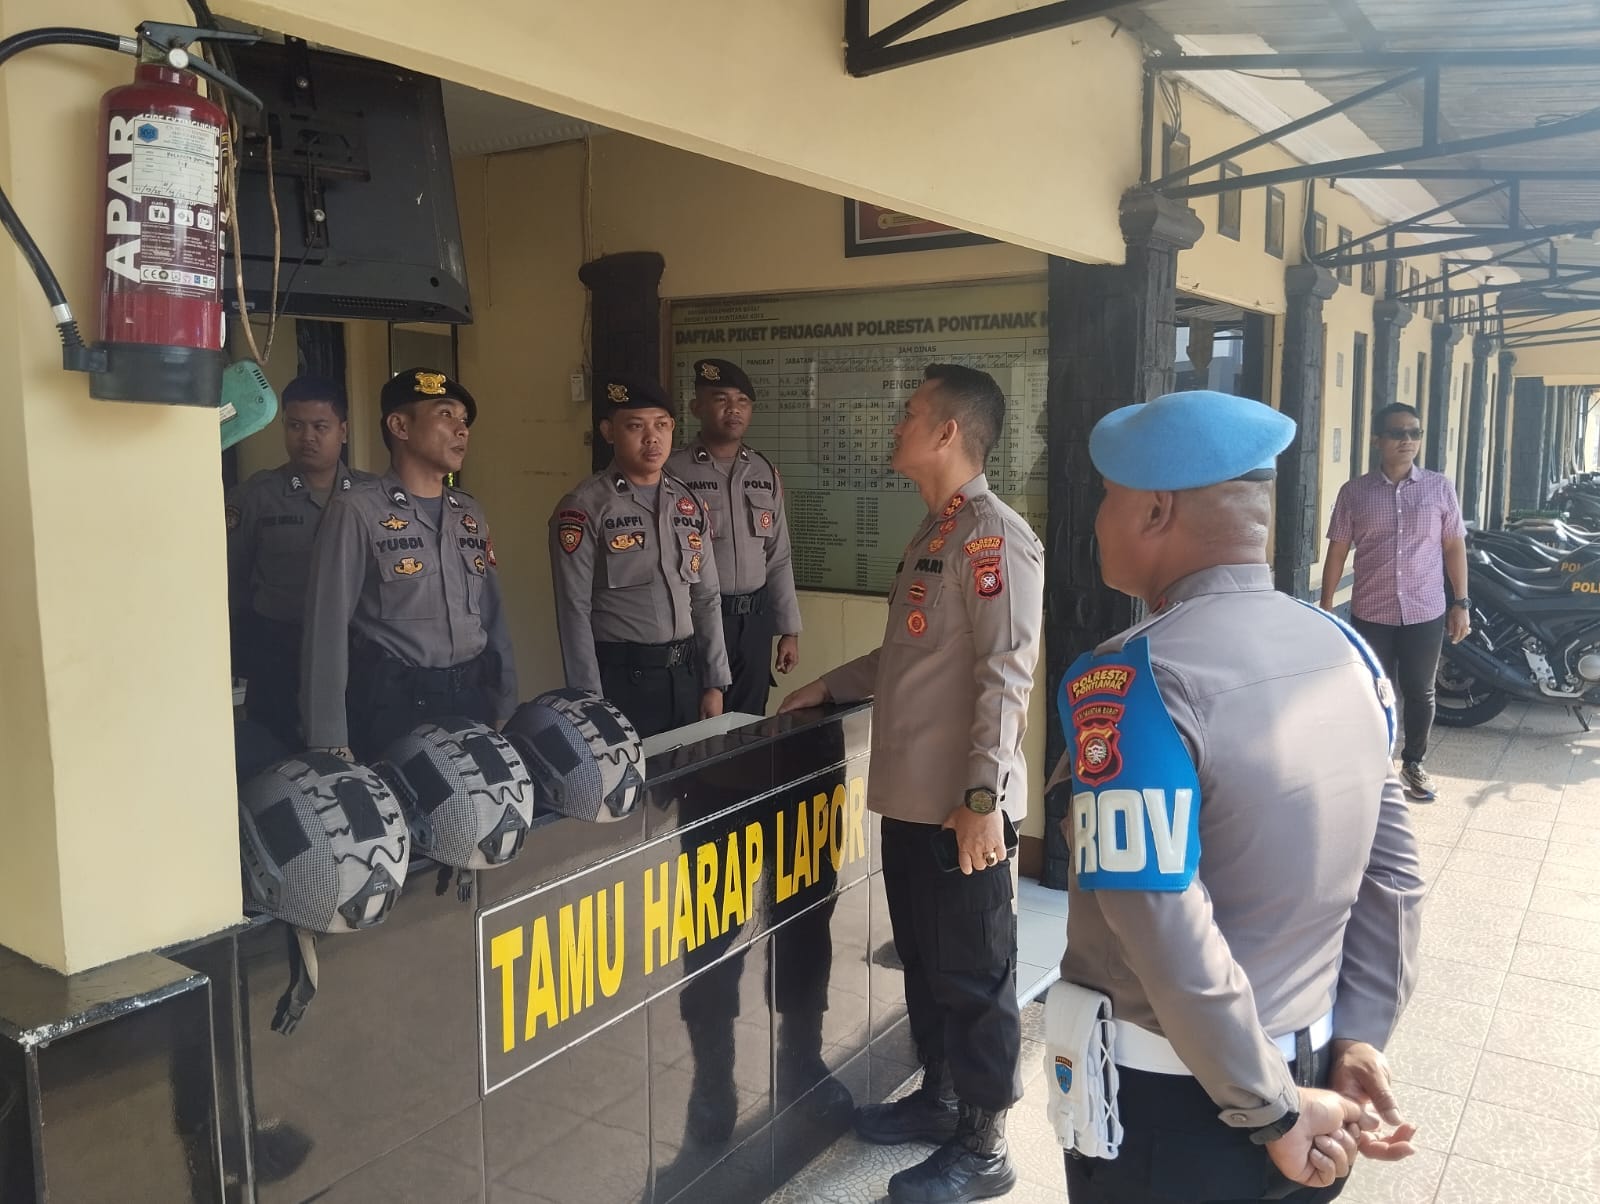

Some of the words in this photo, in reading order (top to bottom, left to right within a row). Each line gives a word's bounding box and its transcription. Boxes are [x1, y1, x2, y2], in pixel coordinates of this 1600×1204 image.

[105, 113, 143, 284] APAR
[676, 327, 725, 345] DAFTAR
[728, 326, 768, 342] PIKET
[770, 322, 852, 340] PENJAGAAN
[856, 316, 935, 336] POLRESTA
[938, 312, 1037, 332] PONTIANAK
[744, 480, 772, 490] POLRI
[605, 516, 644, 530] GAFFI
[376, 536, 424, 553] YUSDI
[1072, 669, 1128, 692] POLRESTA
[1076, 680, 1123, 698] PONTIANAK
[1073, 788, 1193, 874] ROV
[491, 881, 624, 1053] TAMU
[644, 822, 763, 976] HARAP
[776, 776, 865, 904] LAPOR
